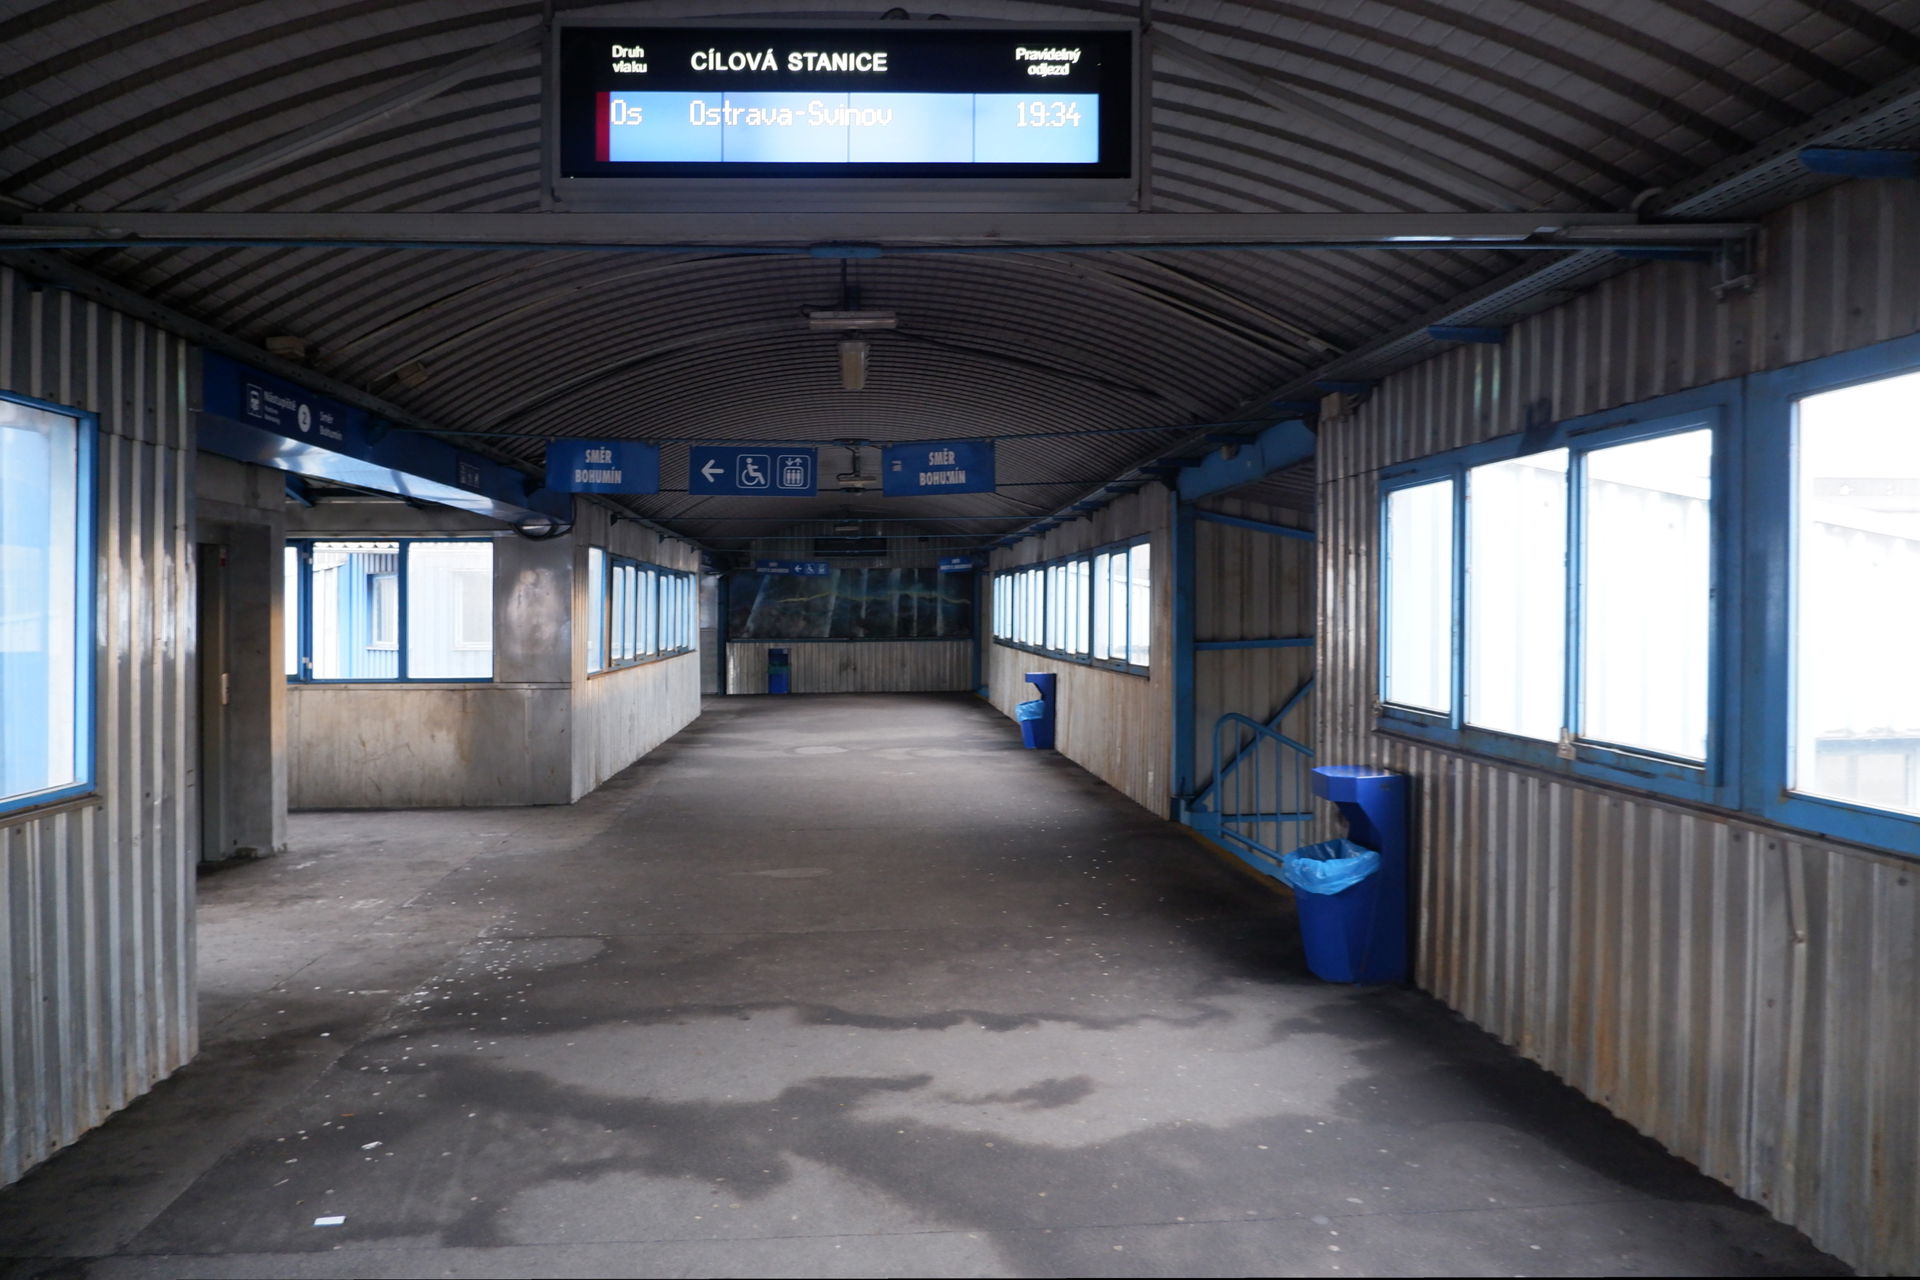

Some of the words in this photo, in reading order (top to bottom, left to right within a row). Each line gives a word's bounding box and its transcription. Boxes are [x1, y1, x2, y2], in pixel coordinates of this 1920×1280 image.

[612, 44, 645, 58] Druh
[690, 48, 778, 71] CÍLOVÁ
[787, 52, 888, 72] STANICE
[1015, 46, 1081, 63] Pravidelný
[612, 60, 647, 73] vlaku
[1027, 62, 1070, 77] odjezd
[689, 99, 894, 126] Ostrava-Svinov
[1016, 101, 1081, 128] 19:34
[585, 446, 612, 463] SMĚR
[928, 448, 955, 466] SMĚR
[575, 466, 622, 484] BOHUMÍN
[919, 467, 966, 487] BOHUMÍN
